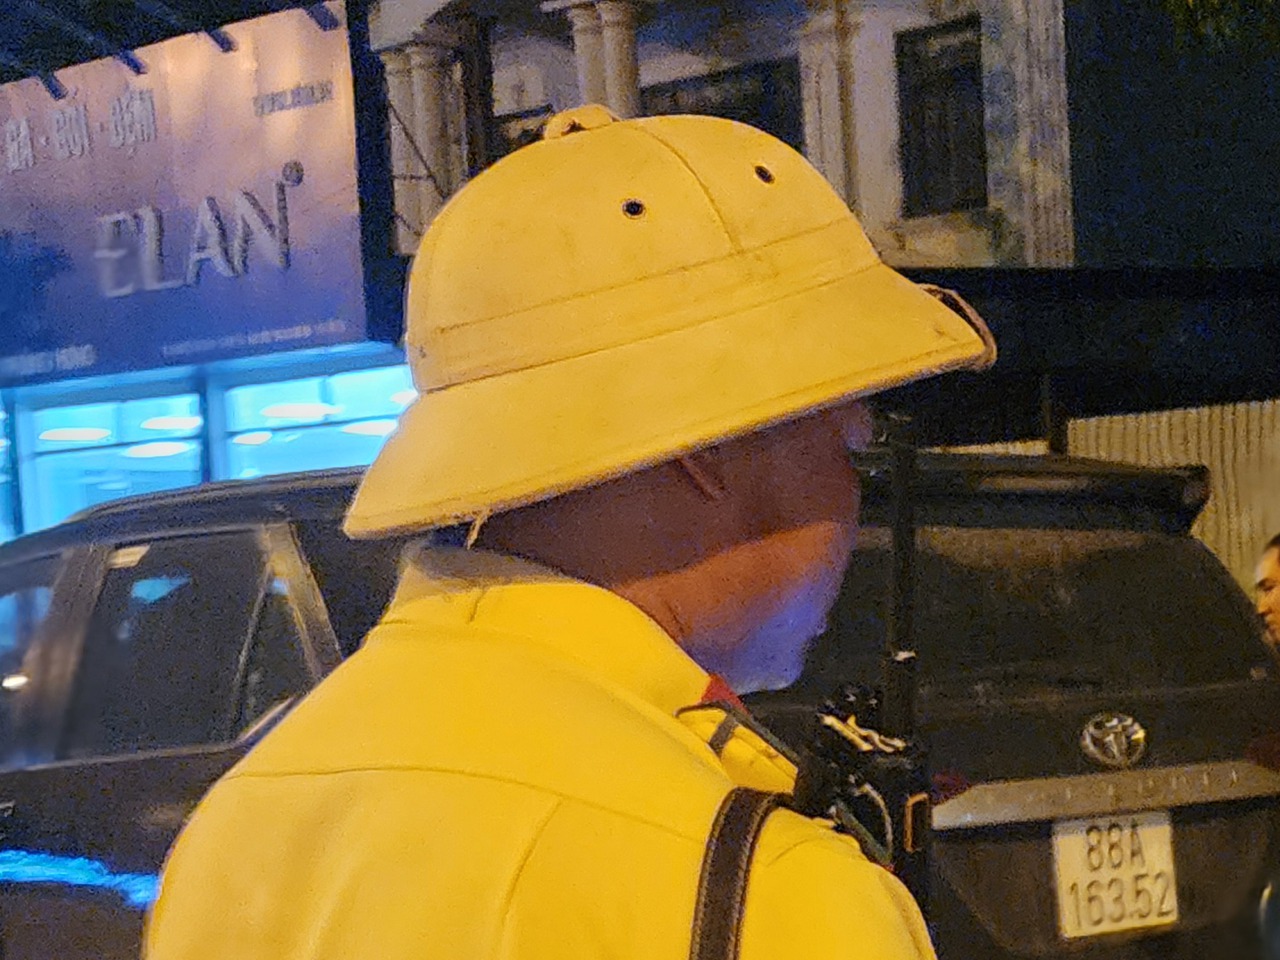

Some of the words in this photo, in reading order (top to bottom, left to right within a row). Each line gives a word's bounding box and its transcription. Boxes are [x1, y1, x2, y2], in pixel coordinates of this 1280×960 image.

[95, 180, 292, 298] ELAN
[1086, 819, 1145, 872] 88A
[1069, 872, 1175, 928] 163.52
